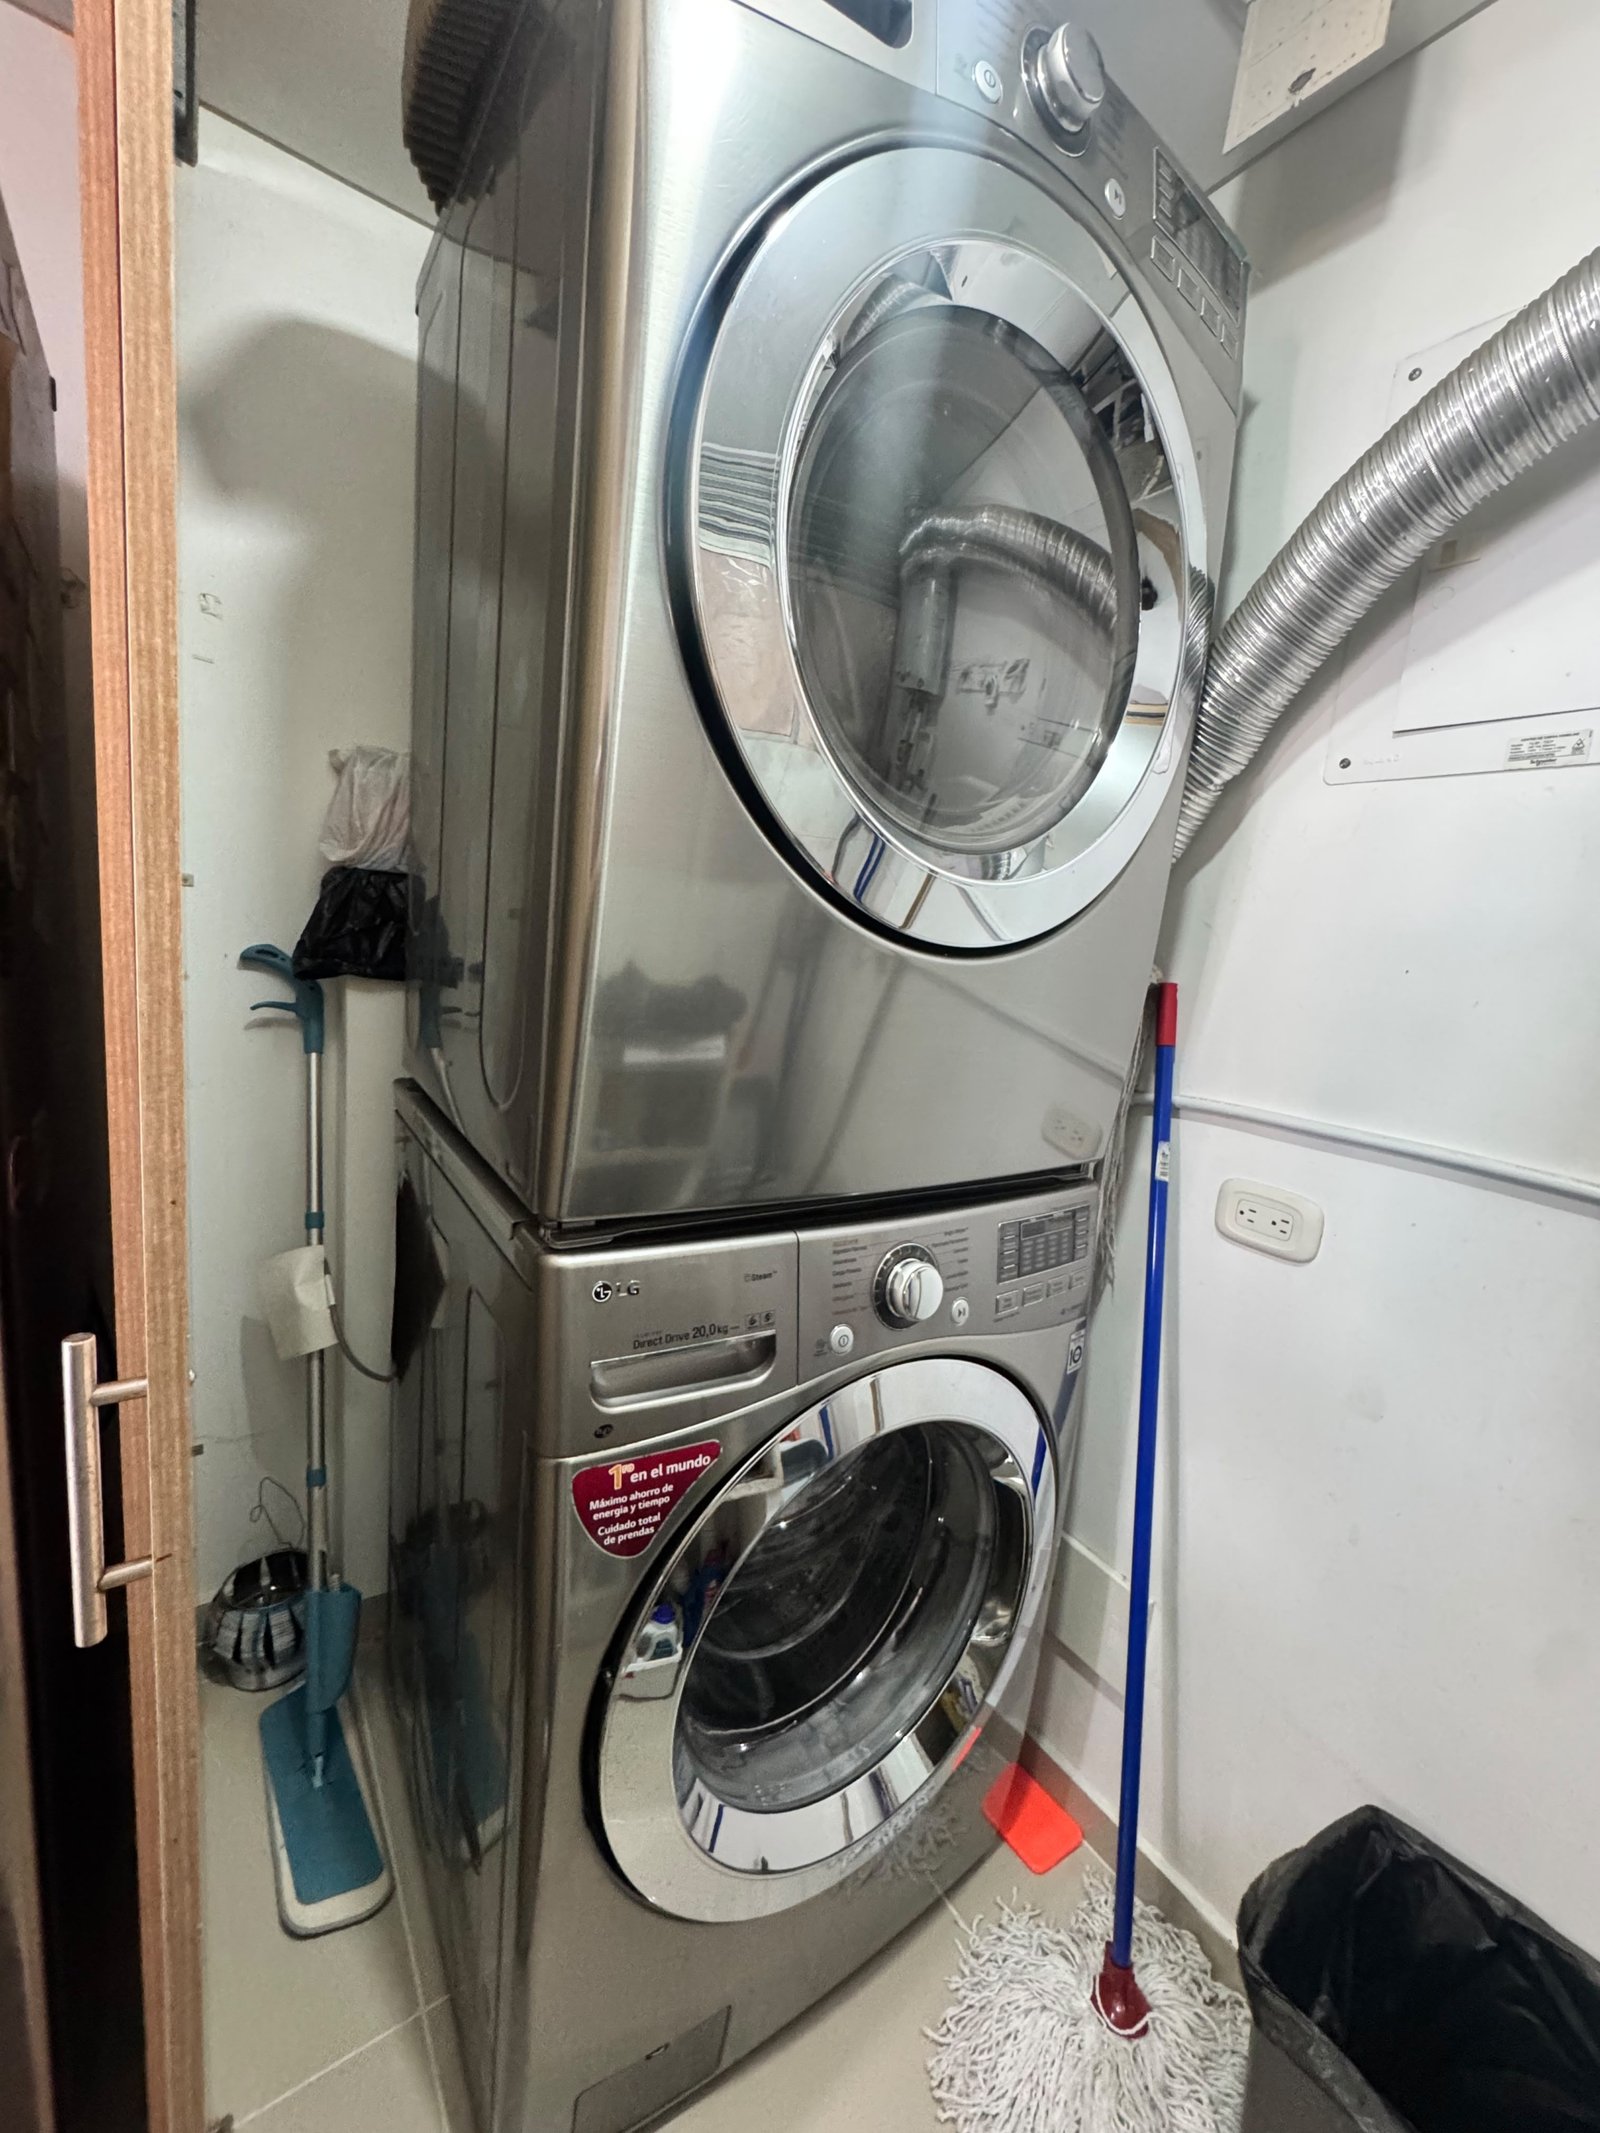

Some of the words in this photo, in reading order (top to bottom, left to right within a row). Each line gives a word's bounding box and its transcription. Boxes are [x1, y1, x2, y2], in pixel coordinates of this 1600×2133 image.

[616, 1279, 641, 1297] LG
[633, 1336, 662, 1350] Direct
[665, 1331, 690, 1344] Drive
[629, 1470, 648, 1484] en
[650, 1463, 664, 1479] el
[666, 1453, 711, 1475] mundo
[588, 1494, 627, 1511] Máximo
[629, 1487, 660, 1502] ahorro
[662, 1482, 674, 1495] de
[630, 1503, 637, 1515] y
[638, 1495, 671, 1510] tiempo
[597, 1518, 636, 1536] Cuidado
[638, 1512, 661, 1526] total
[603, 1535, 616, 1546] de
[617, 1525, 655, 1546] prendas
